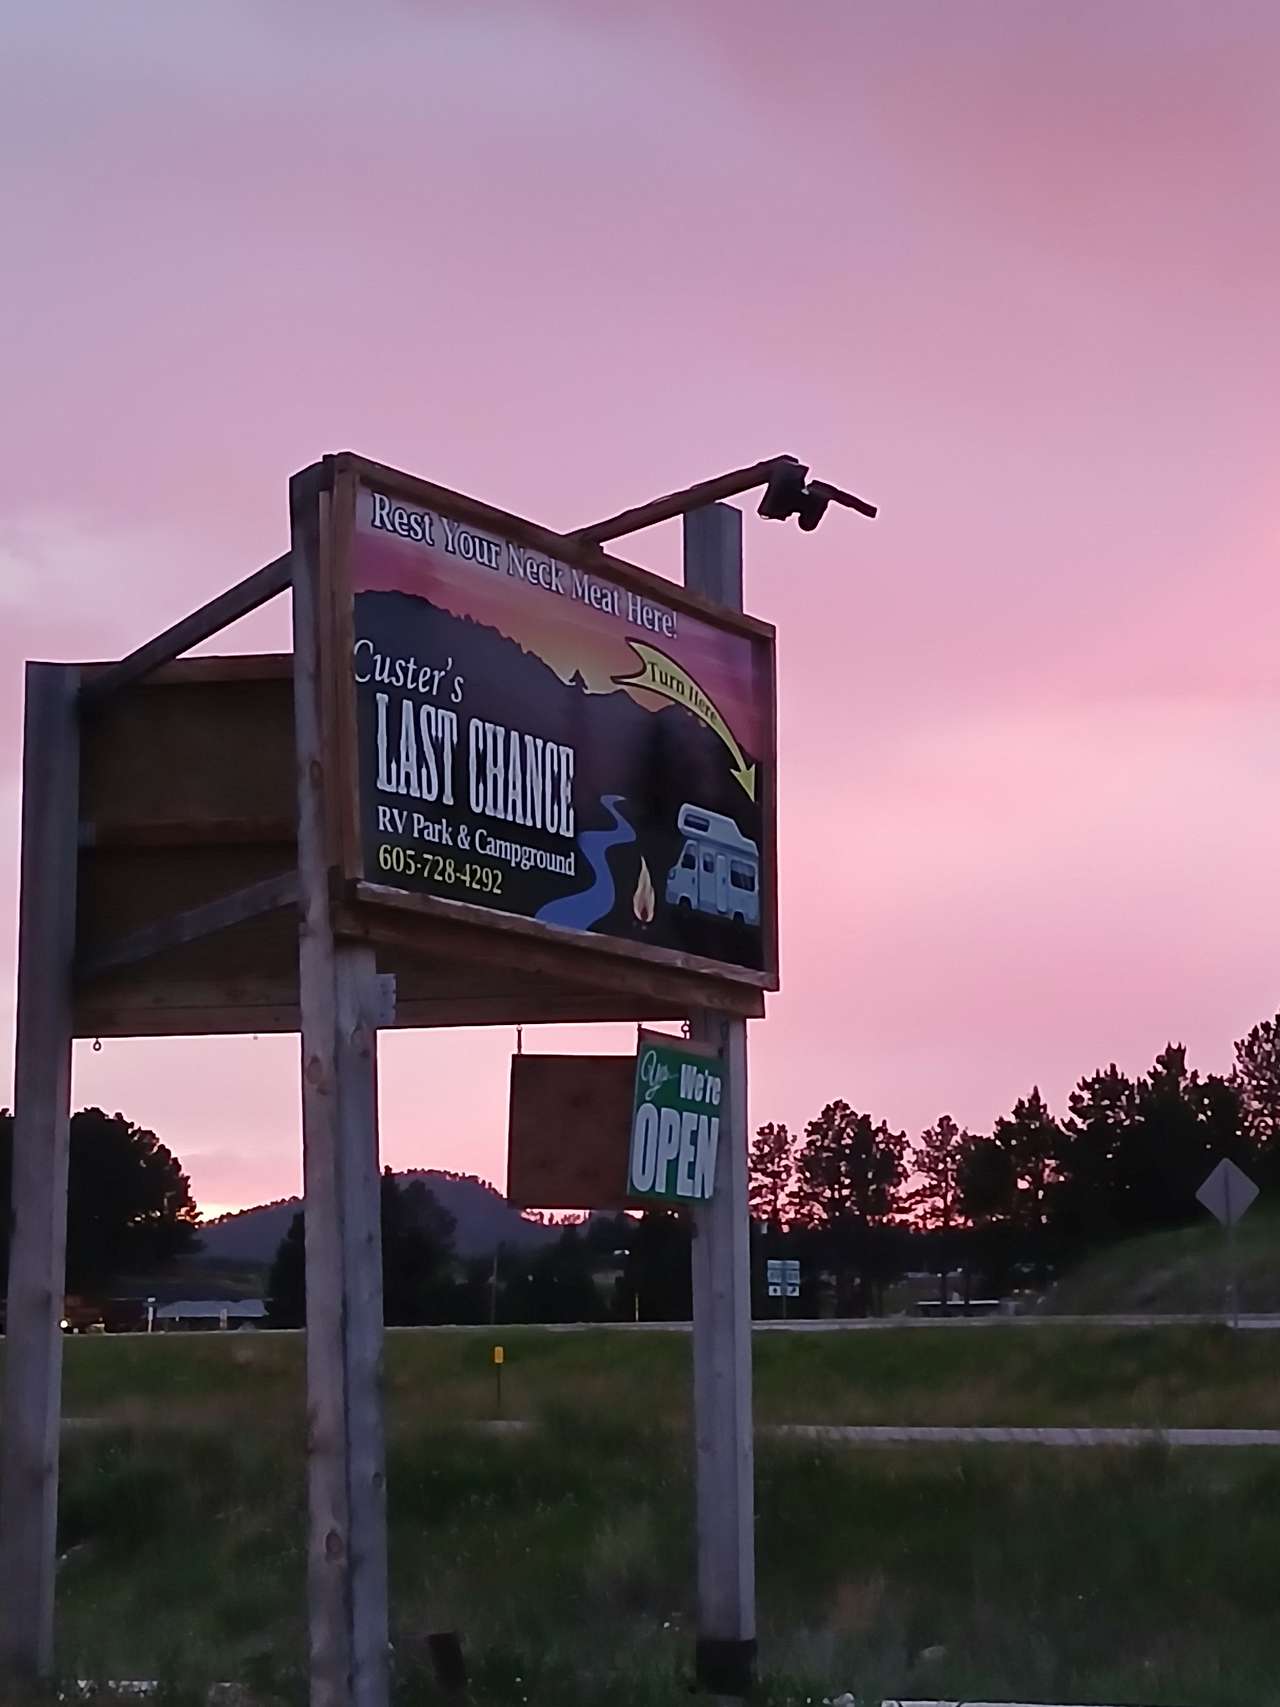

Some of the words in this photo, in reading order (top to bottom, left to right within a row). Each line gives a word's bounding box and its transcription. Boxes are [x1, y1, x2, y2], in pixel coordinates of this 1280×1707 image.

[371, 492, 434, 546] Rest
[440, 517, 500, 569] Your
[507, 543, 565, 594] Neck
[571, 569, 621, 616] Meat
[626, 592, 678, 639] Here!
[353, 639, 464, 703] Custer's
[648, 661, 685, 695] Turn
[688, 685, 718, 722] Here
[375, 693, 458, 805] LAST
[469, 718, 575, 837] CHANCE
[377, 805, 408, 834] RV
[412, 813, 453, 846] Park
[457, 824, 472, 849] &
[475, 829, 575, 876] Campground
[379, 845, 503, 894] 605-728-4292
[680, 1064, 721, 1105] We're
[631, 1102, 719, 1199] OPEN
